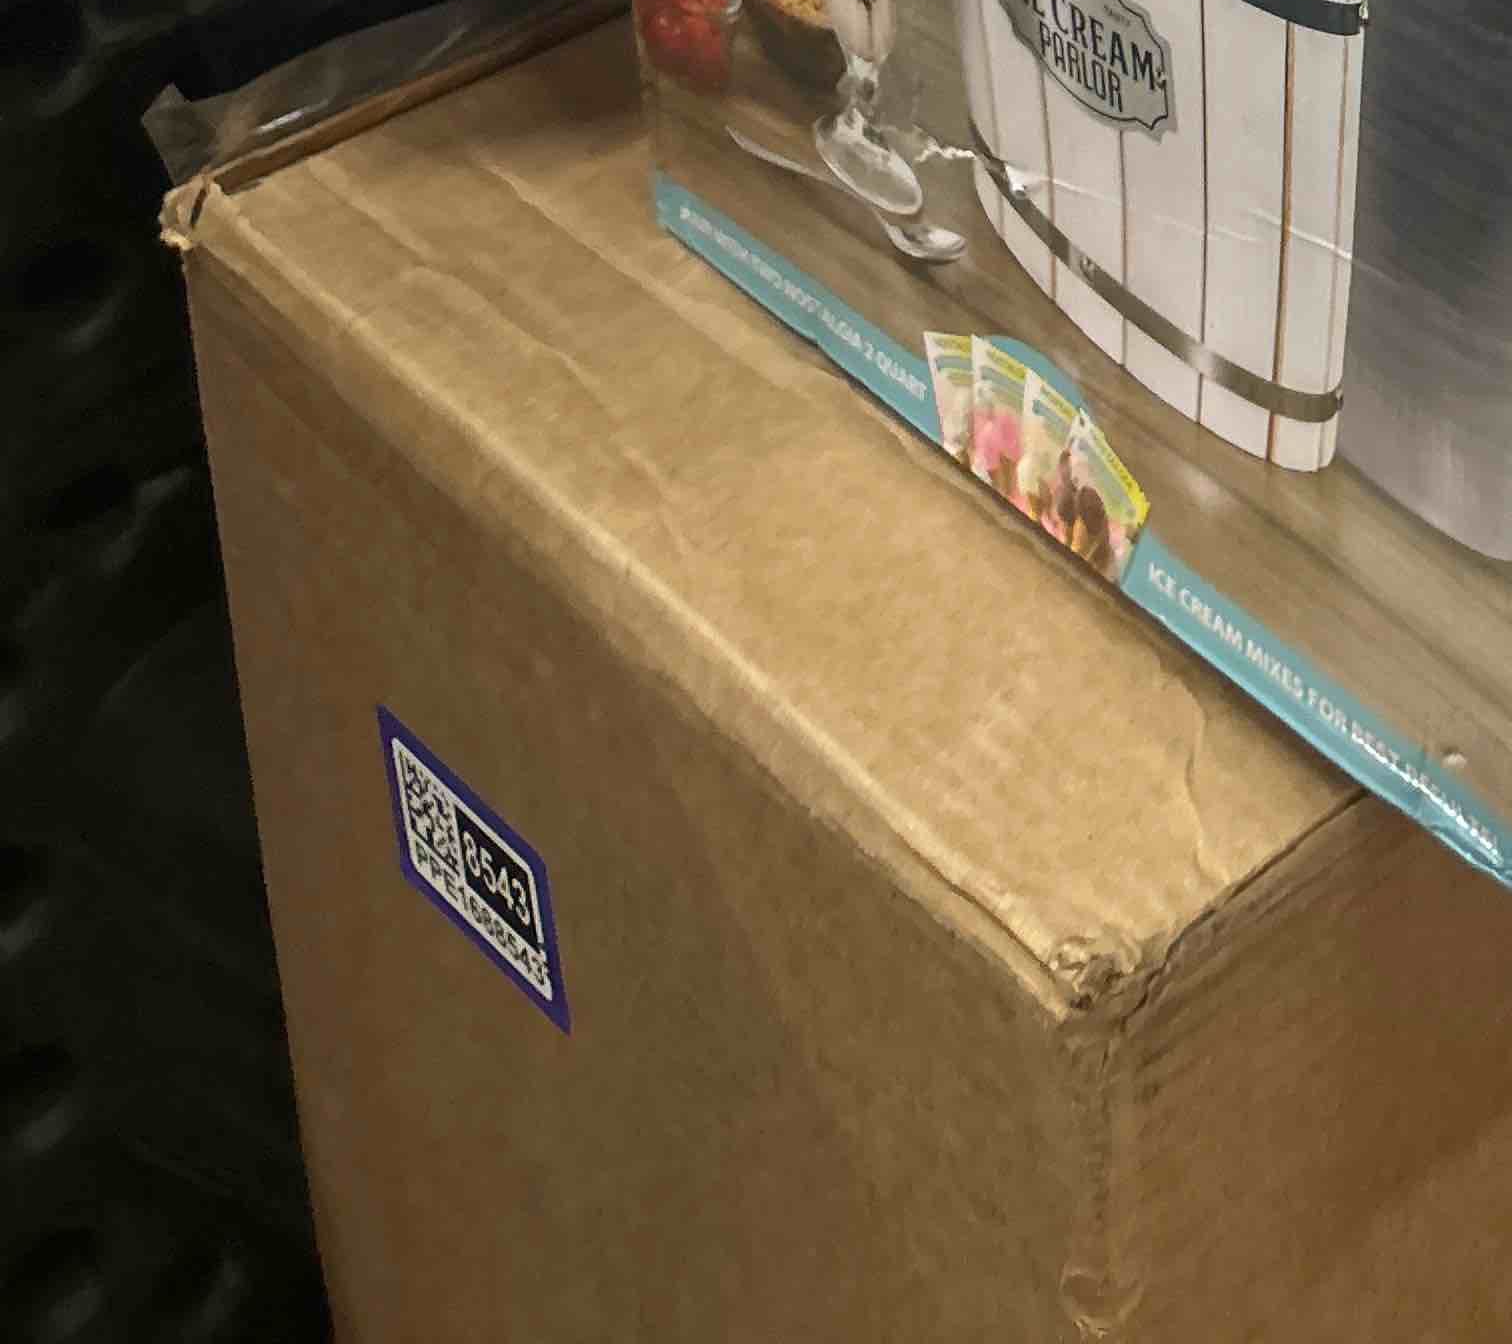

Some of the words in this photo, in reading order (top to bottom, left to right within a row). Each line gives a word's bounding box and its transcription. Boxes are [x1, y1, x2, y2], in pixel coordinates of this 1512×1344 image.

[1039, 21, 1123, 112] PARLOR
[1149, 562, 1176, 598] ICE
[1179, 587, 1244, 652] CREAM
[1246, 639, 1304, 699] MIXES
[1307, 687, 1348, 734] FOR
[462, 831, 531, 928] 8543
